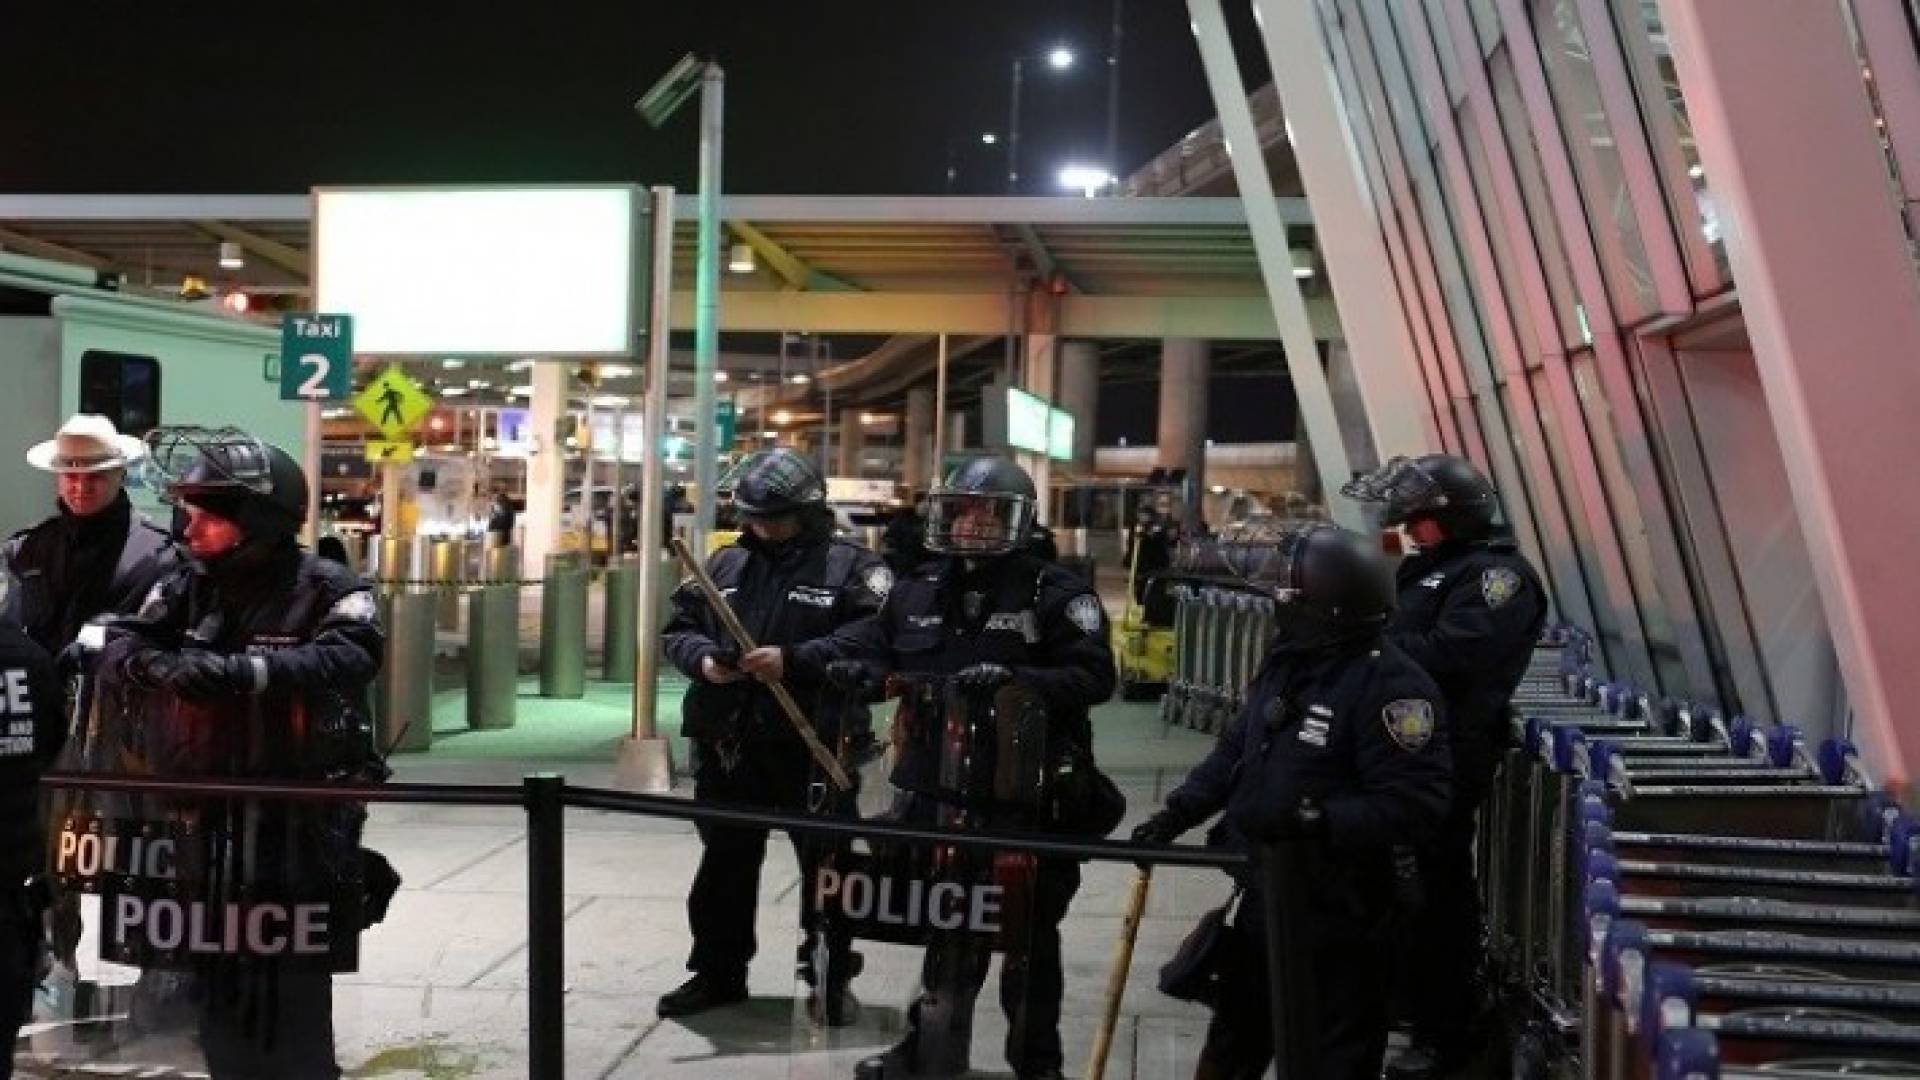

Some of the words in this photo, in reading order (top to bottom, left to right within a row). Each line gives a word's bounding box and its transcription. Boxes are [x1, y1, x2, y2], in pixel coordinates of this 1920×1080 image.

[293, 318, 341, 338] Taxi
[297, 353, 330, 397] 2
[114, 893, 331, 955] POLICE
[814, 868, 1004, 933] POLICE
